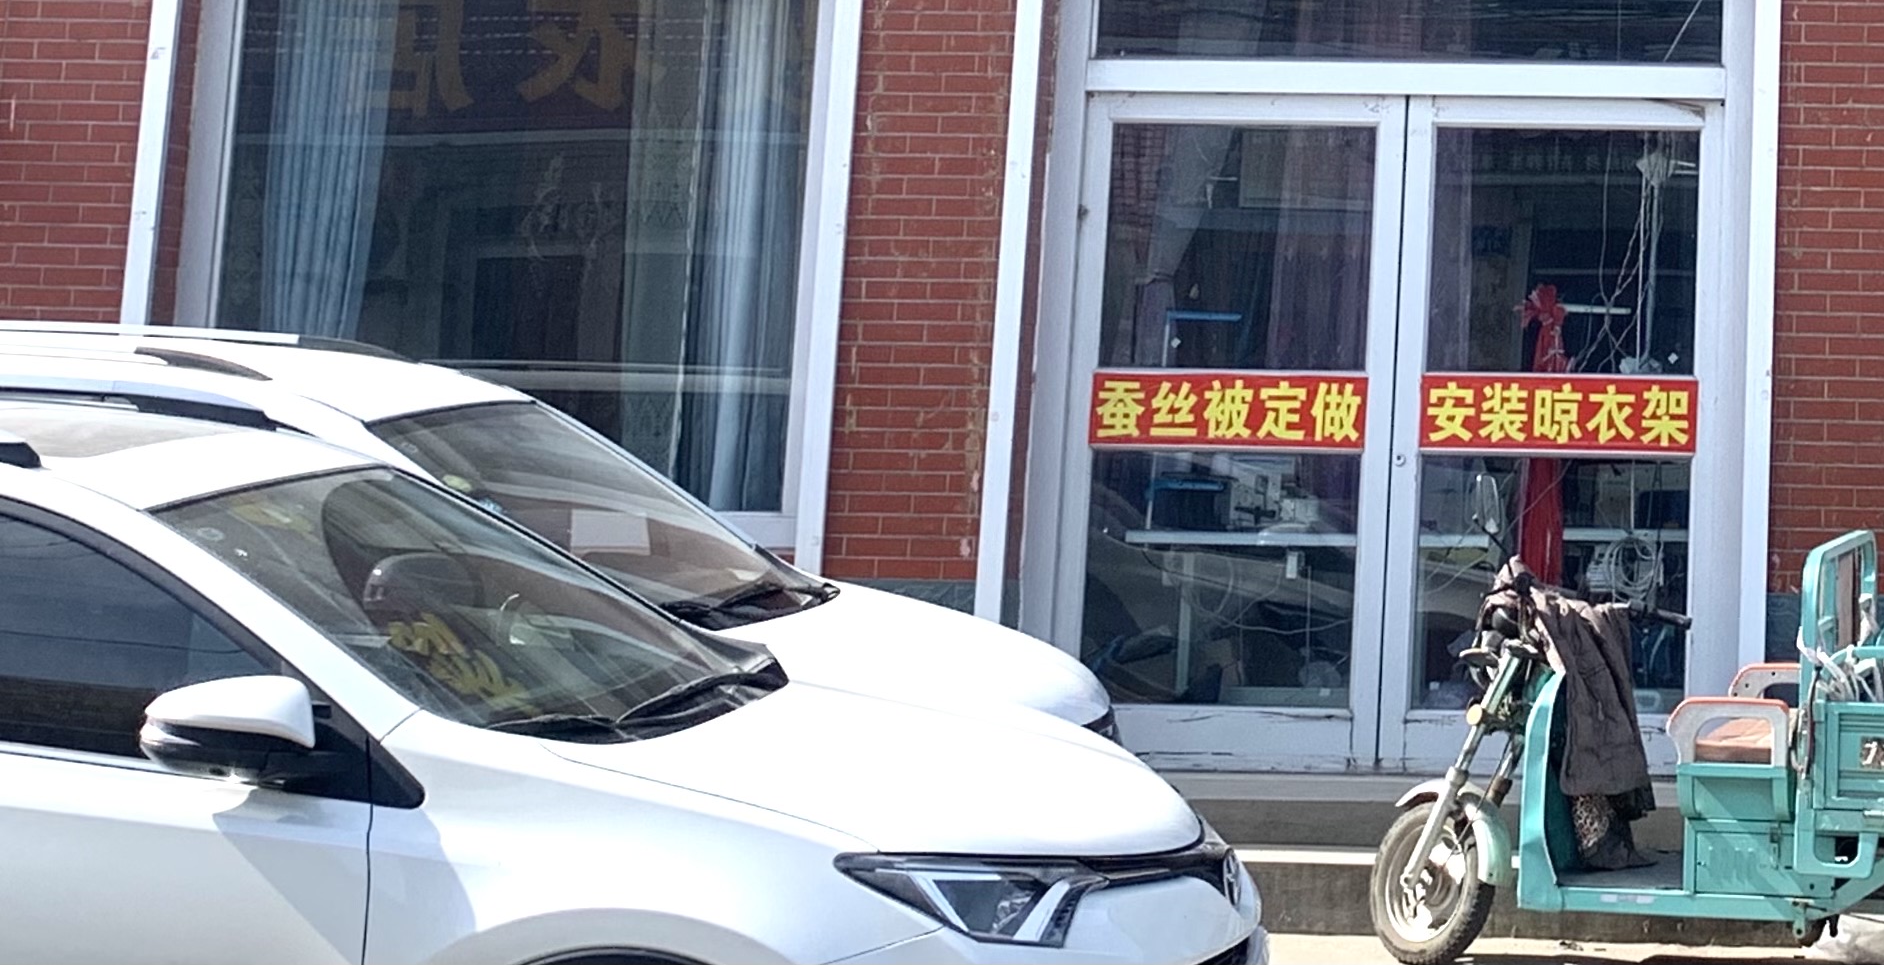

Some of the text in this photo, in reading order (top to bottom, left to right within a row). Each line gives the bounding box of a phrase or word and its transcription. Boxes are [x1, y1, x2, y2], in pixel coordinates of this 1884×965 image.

[1096, 380, 1361, 442] 蚕丝被定做
[1427, 381, 1689, 447] 安装晾衣架
